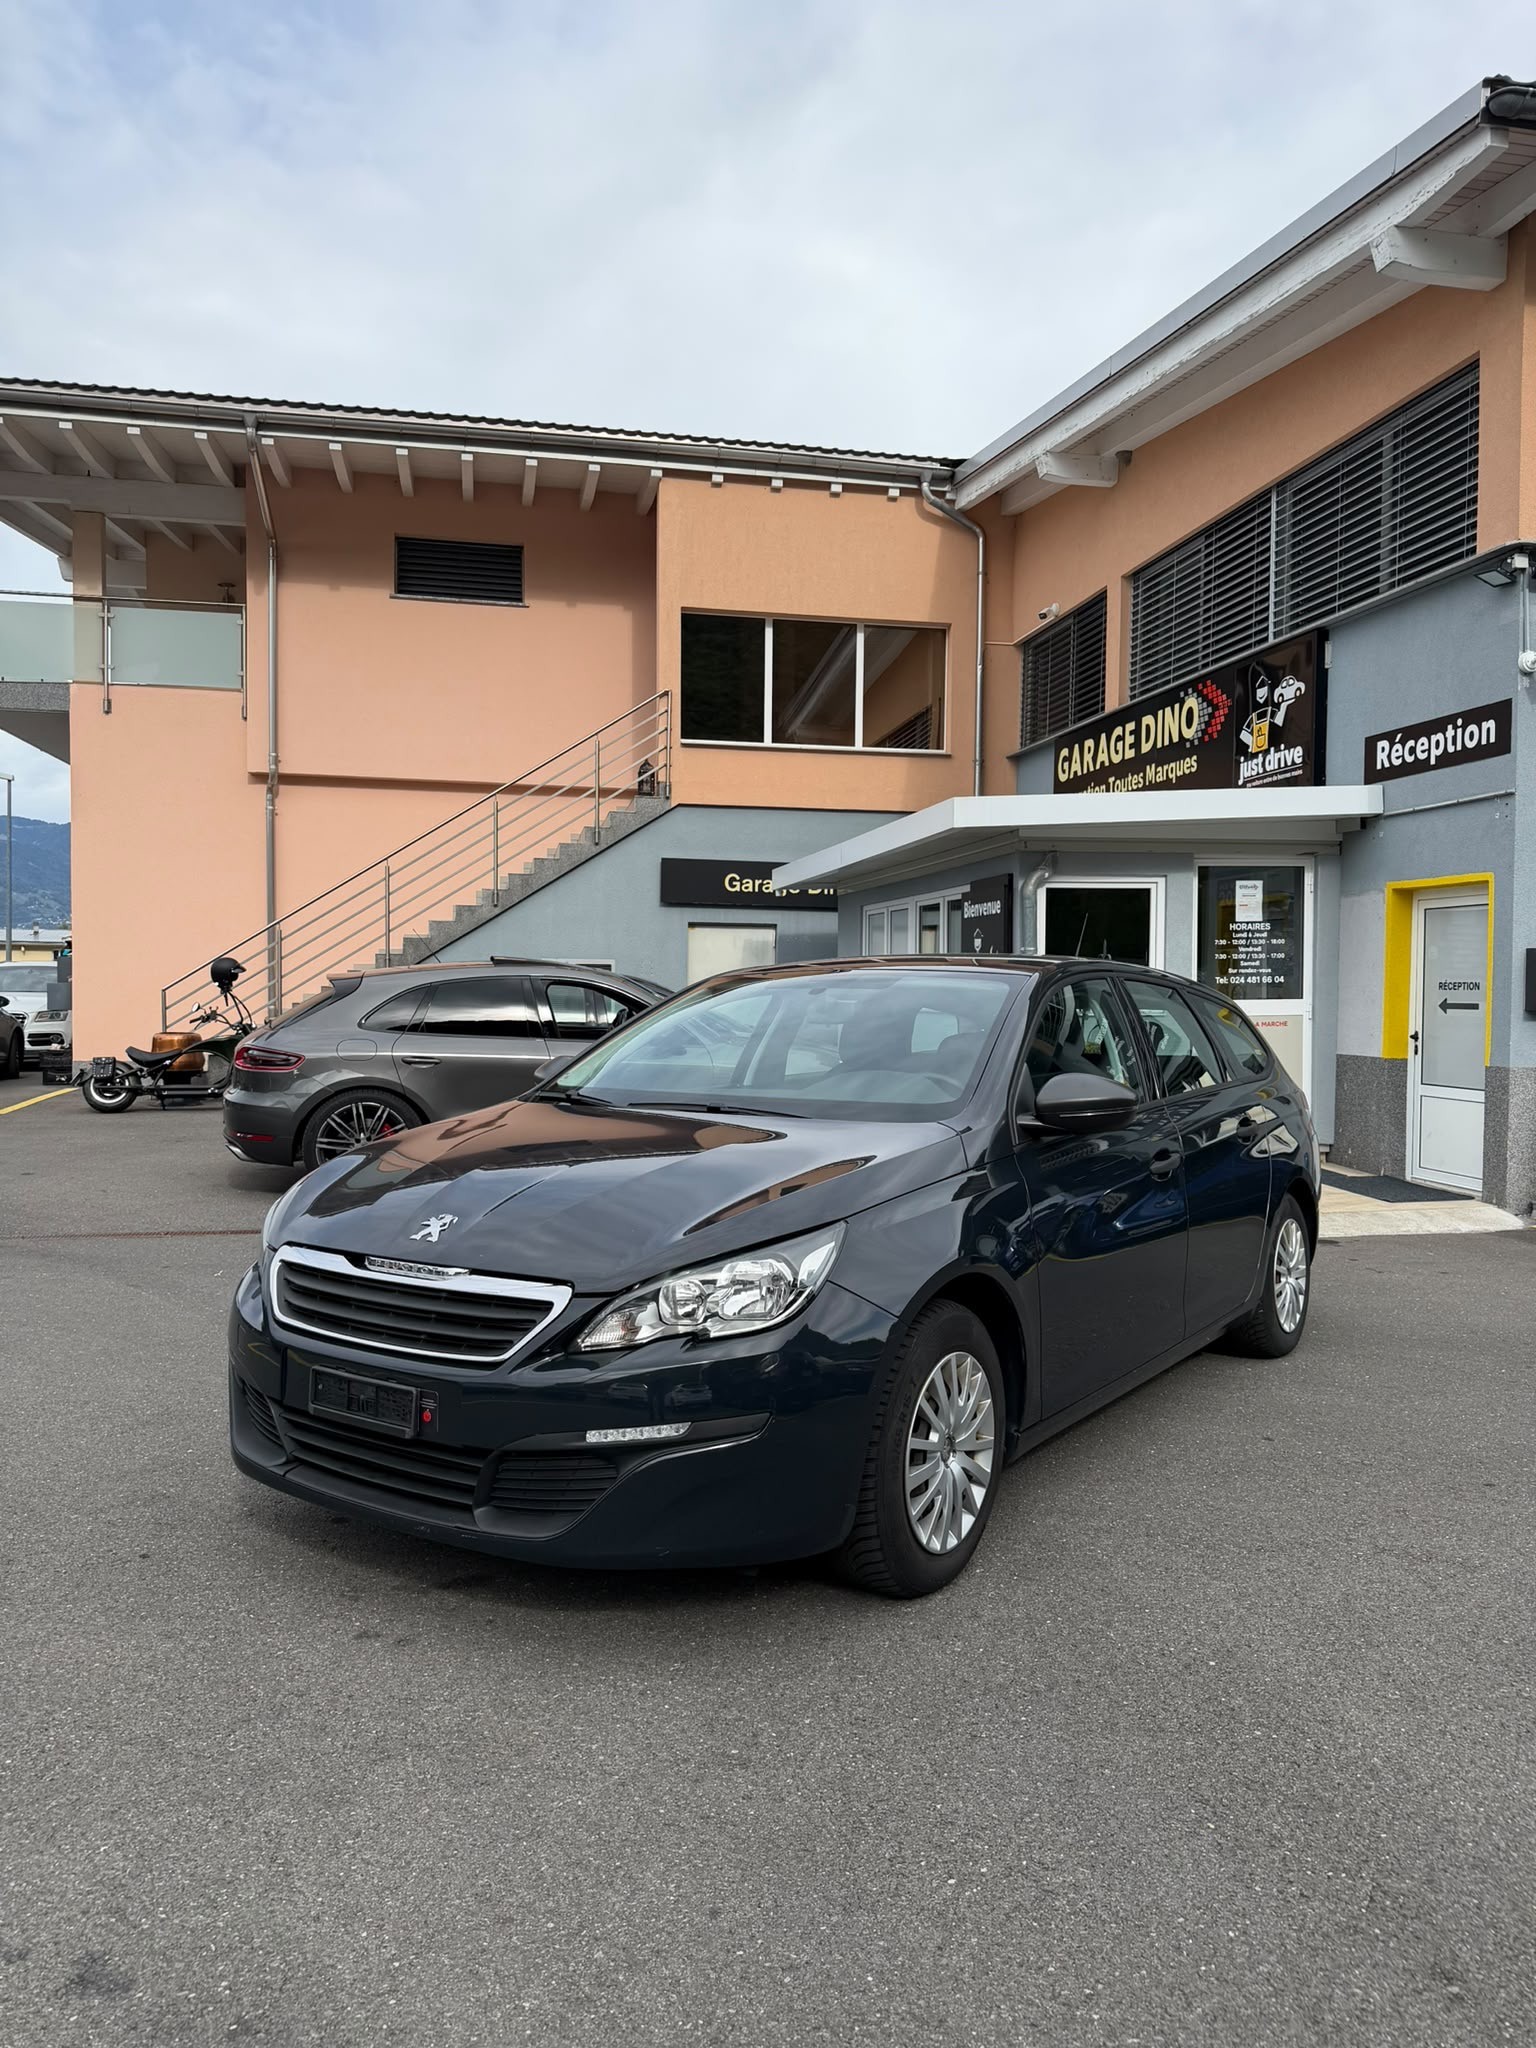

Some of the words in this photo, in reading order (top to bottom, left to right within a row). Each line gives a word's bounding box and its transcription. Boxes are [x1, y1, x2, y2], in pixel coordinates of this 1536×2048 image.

[1057, 720, 1136, 783] GARAGE
[1141, 696, 1199, 754] DINO
[1376, 717, 1496, 770] Réception
[1108, 772, 1144, 794] Toutes
[1145, 755, 1198, 786] Marques
[1238, 753, 1264, 786] just
[1265, 743, 1303, 771] drive
[724, 873, 800, 897] Gara
[963, 900, 1001, 918] Bienvenue
[1229, 922, 1271, 931] HORAIRES
[1230, 976, 1245, 984] 024
[1246, 975, 1261, 983] 481
[1262, 975, 1273, 983] 66
[1273, 975, 1285, 983] 04
[1438, 979, 1480, 991] RÉCEPTION
[1261, 1020, 1289, 1028] MARCHE
